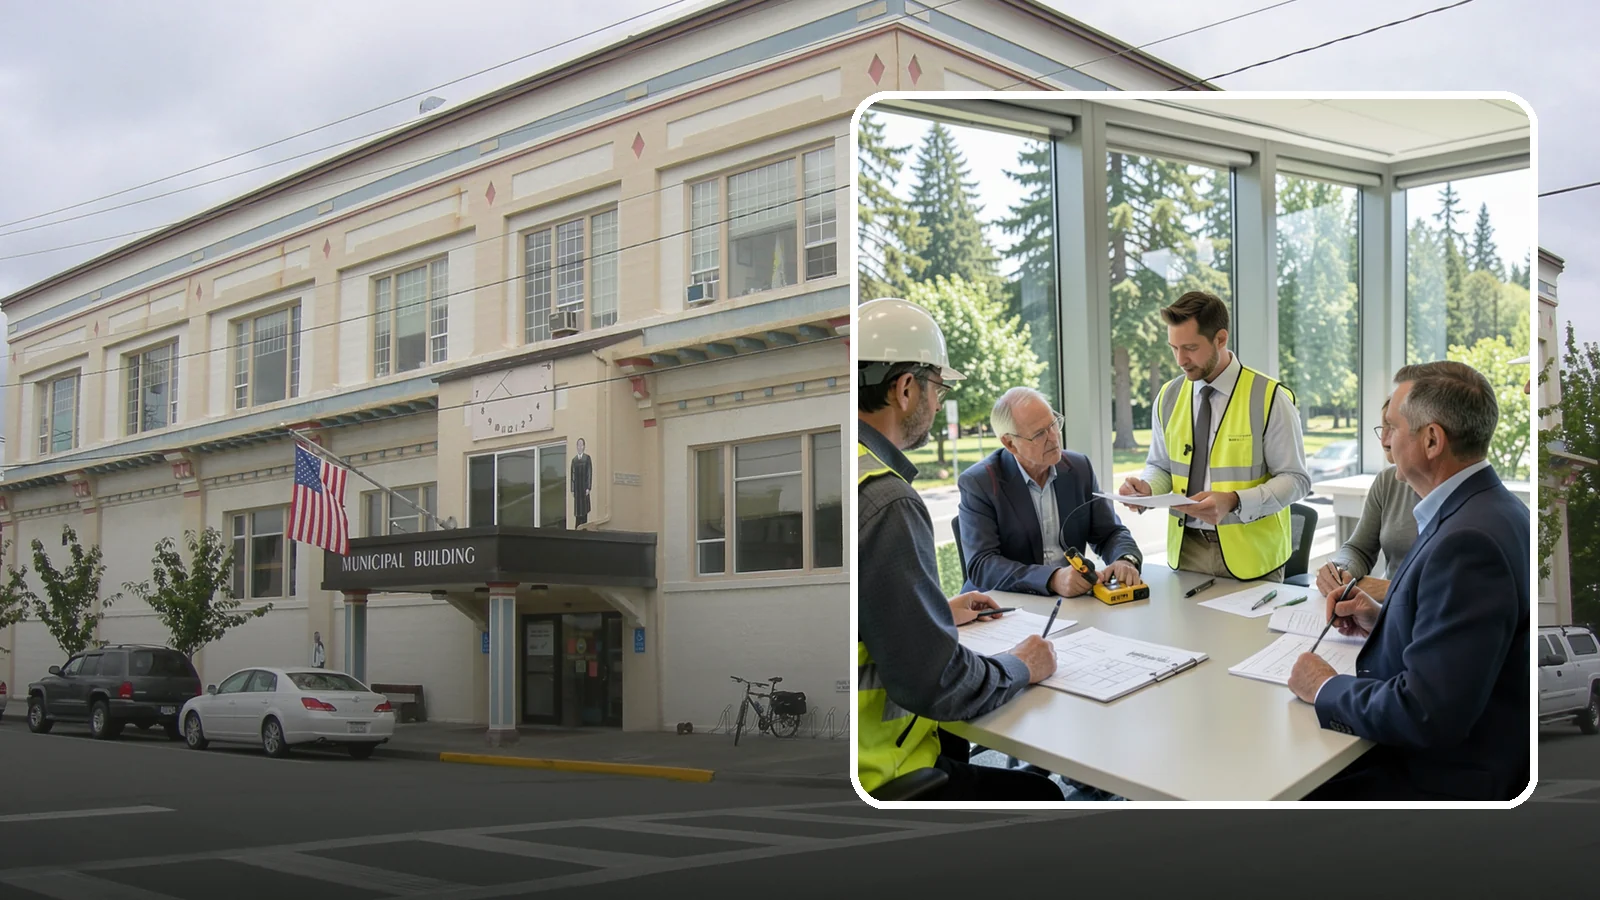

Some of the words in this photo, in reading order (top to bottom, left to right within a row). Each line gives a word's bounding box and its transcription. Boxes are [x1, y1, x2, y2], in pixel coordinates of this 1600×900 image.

[546, 362, 552, 370] 6
[475, 390, 479, 398] 7
[536, 402, 540, 410] 4
[481, 406, 485, 415] 8
[488, 417, 492, 426] 9
[529, 414, 533, 422] 3
[494, 423, 500, 432] 10
[521, 420, 525, 428] 2
[507, 425, 513, 433] 12
[342, 552, 405, 572] MUNICIPAL
[414, 546, 475, 567] BUILDING
